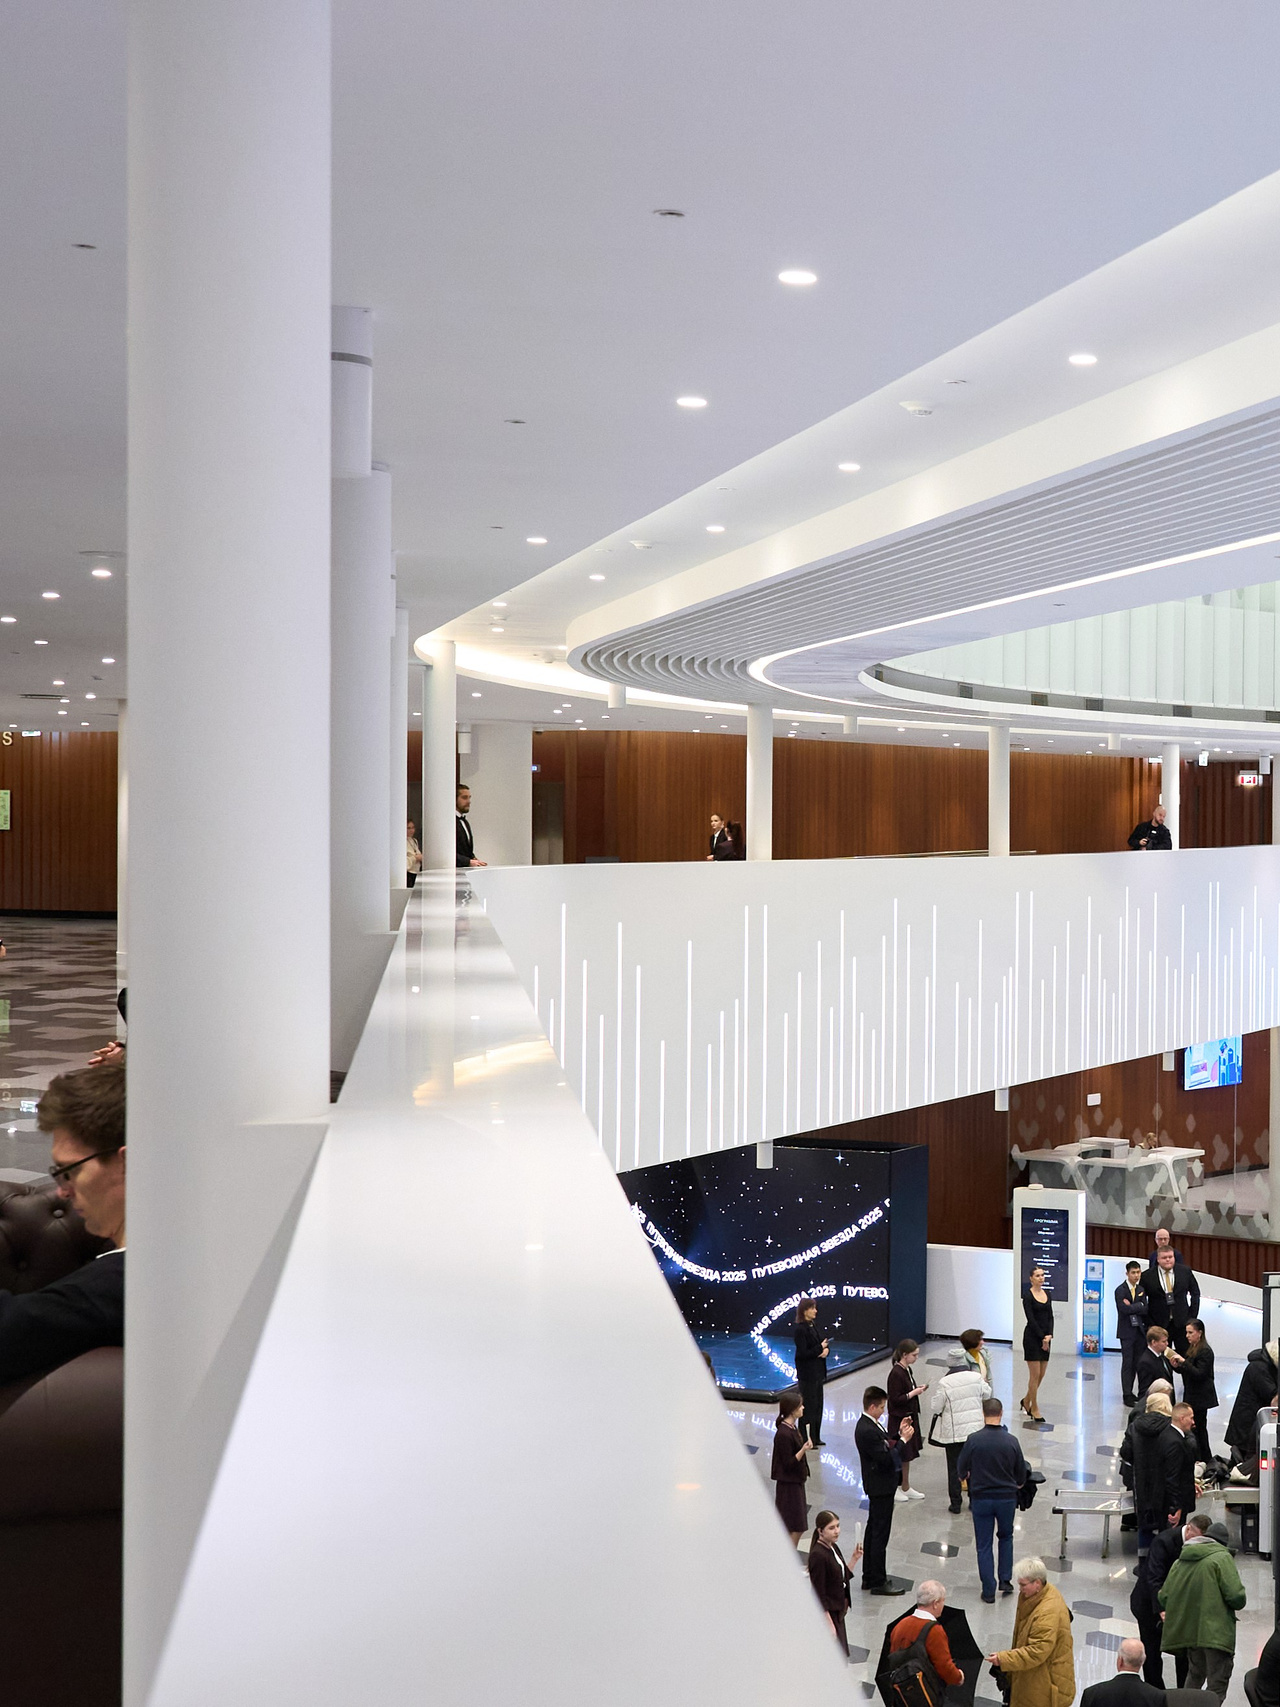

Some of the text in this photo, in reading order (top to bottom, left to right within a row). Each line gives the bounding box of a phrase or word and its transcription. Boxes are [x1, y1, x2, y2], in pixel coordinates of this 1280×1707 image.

[682, 1259, 721, 1283] ЗВЕЗДА
[721, 1271, 747, 1282] 2025
[751, 1245, 821, 1279] ПУТЕВОДНАЯ
[819, 1224, 861, 1253] ЗВЕЗДА
[857, 1206, 884, 1230] 2025
[808, 1284, 837, 1299] 2025
[842, 1285, 890, 1300] ПУТЕВО
